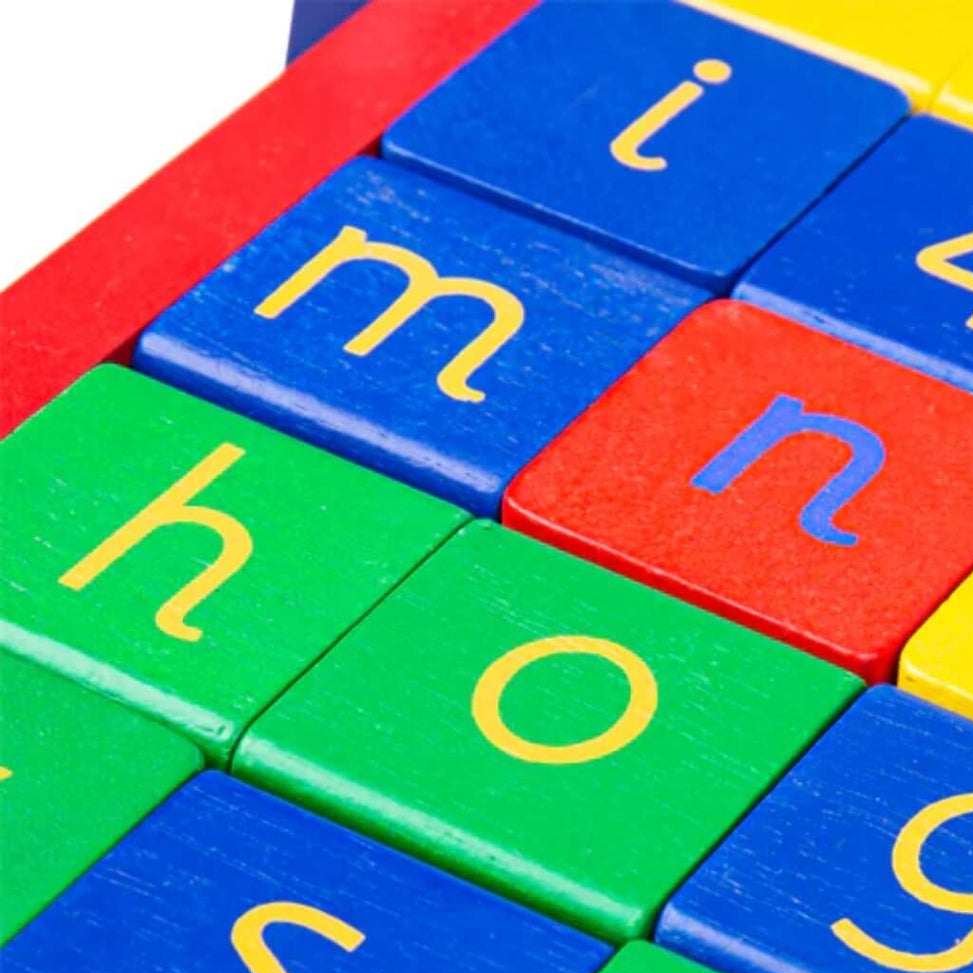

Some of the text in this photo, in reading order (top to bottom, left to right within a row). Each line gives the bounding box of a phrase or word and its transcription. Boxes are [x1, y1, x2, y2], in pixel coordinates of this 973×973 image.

[611, 60, 731, 170] i
[255, 226, 524, 402] m
[60, 444, 253, 640] h
[691, 394, 886, 546] n
[472, 636, 657, 763] o
